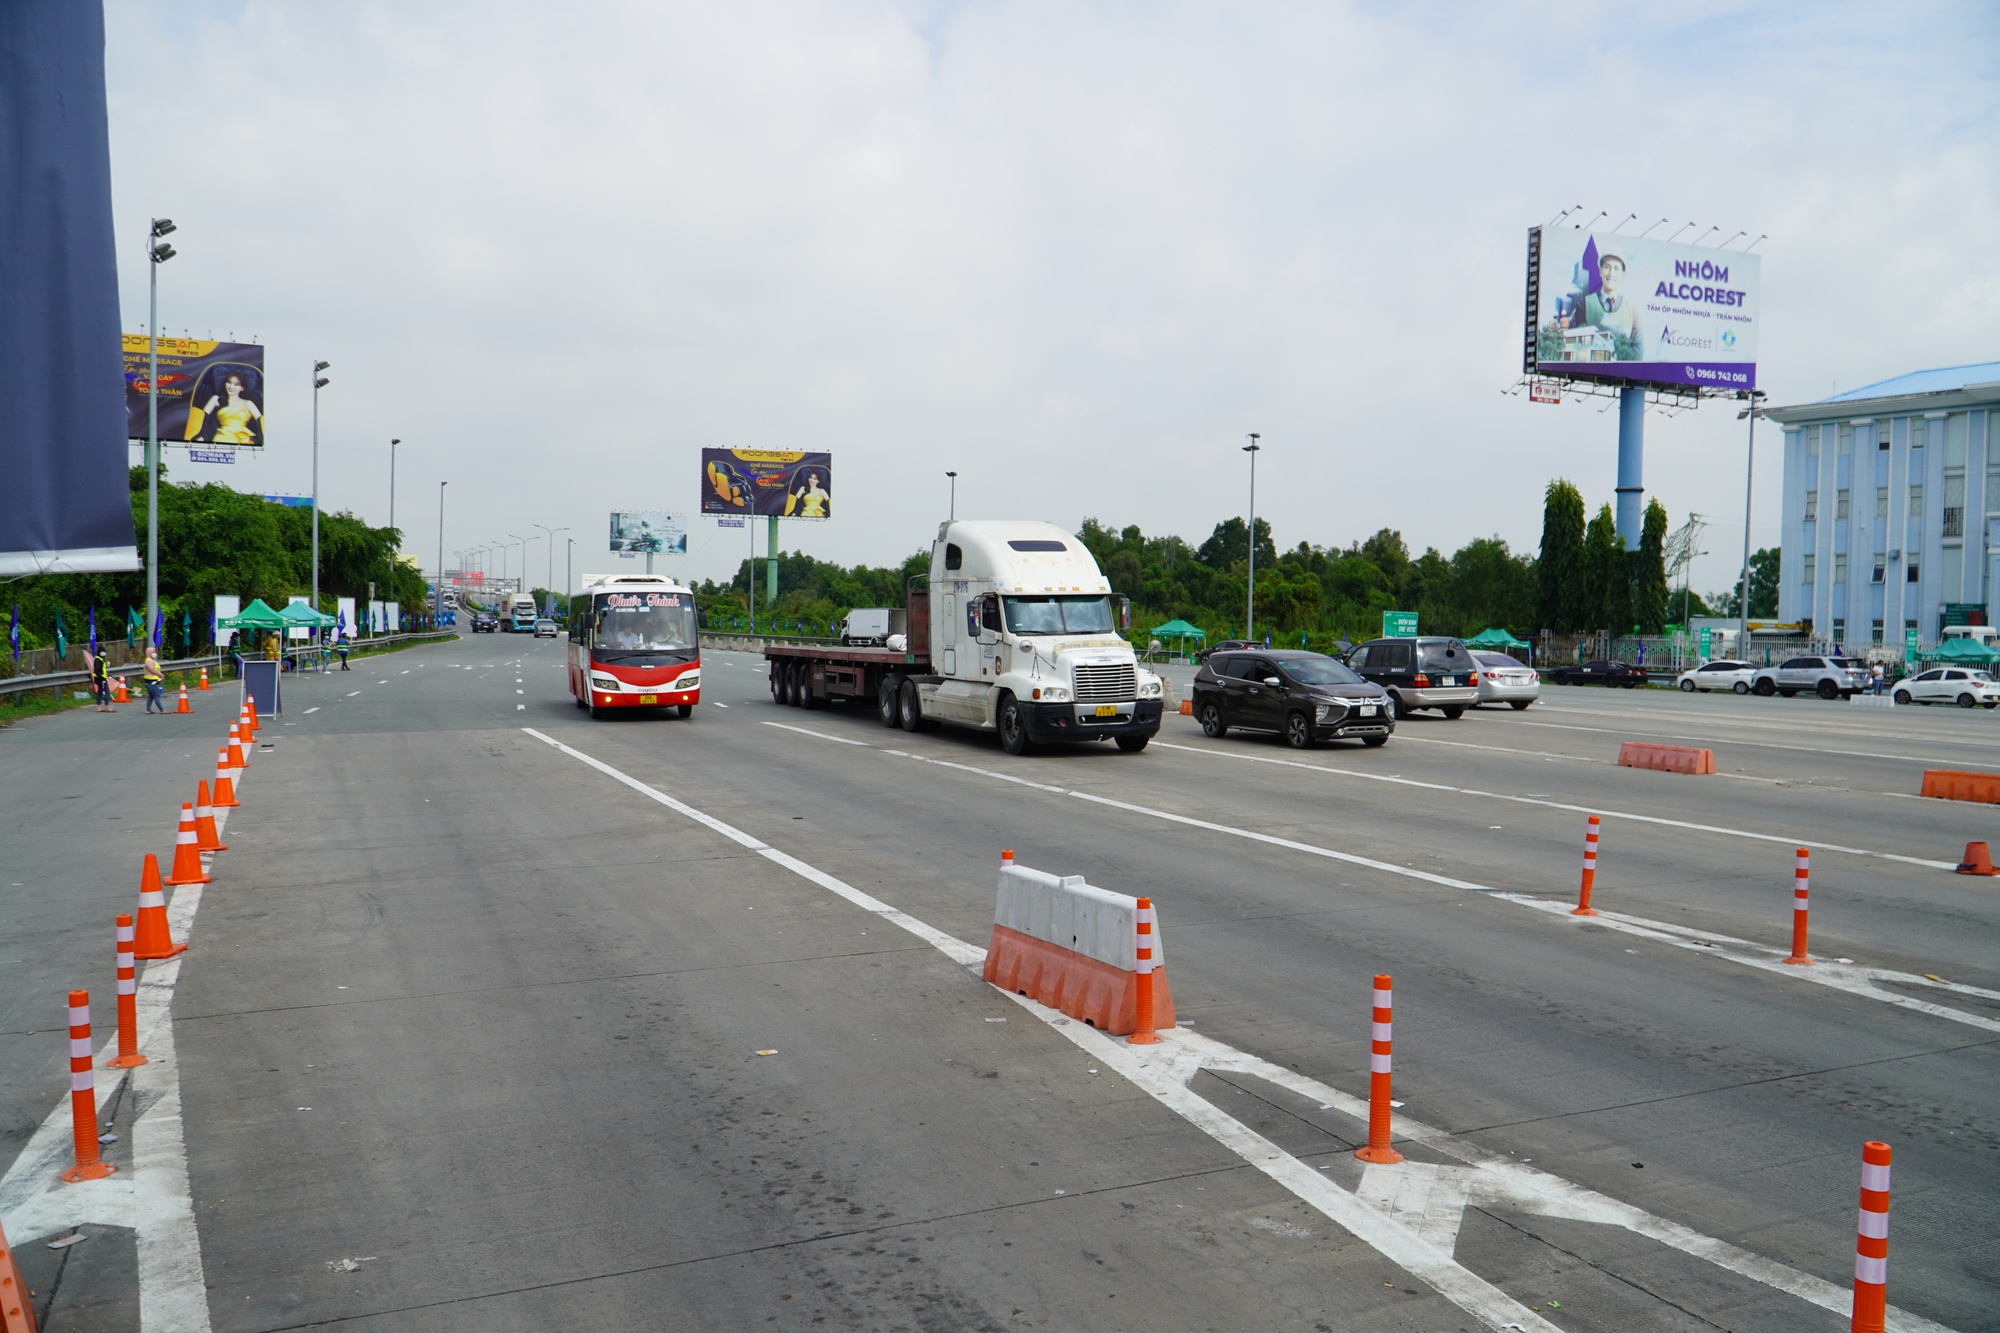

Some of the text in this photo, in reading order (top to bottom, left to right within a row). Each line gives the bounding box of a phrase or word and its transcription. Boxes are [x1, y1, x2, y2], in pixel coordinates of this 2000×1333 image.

[1675, 260, 1729, 283] NHÔM
[1655, 281, 1746, 307] ALCOREST
[142, 356, 183, 366] MSSAGE
[1697, 369, 1747, 383] 0966 742 068
[607, 593, 680, 610] Phước Thành
